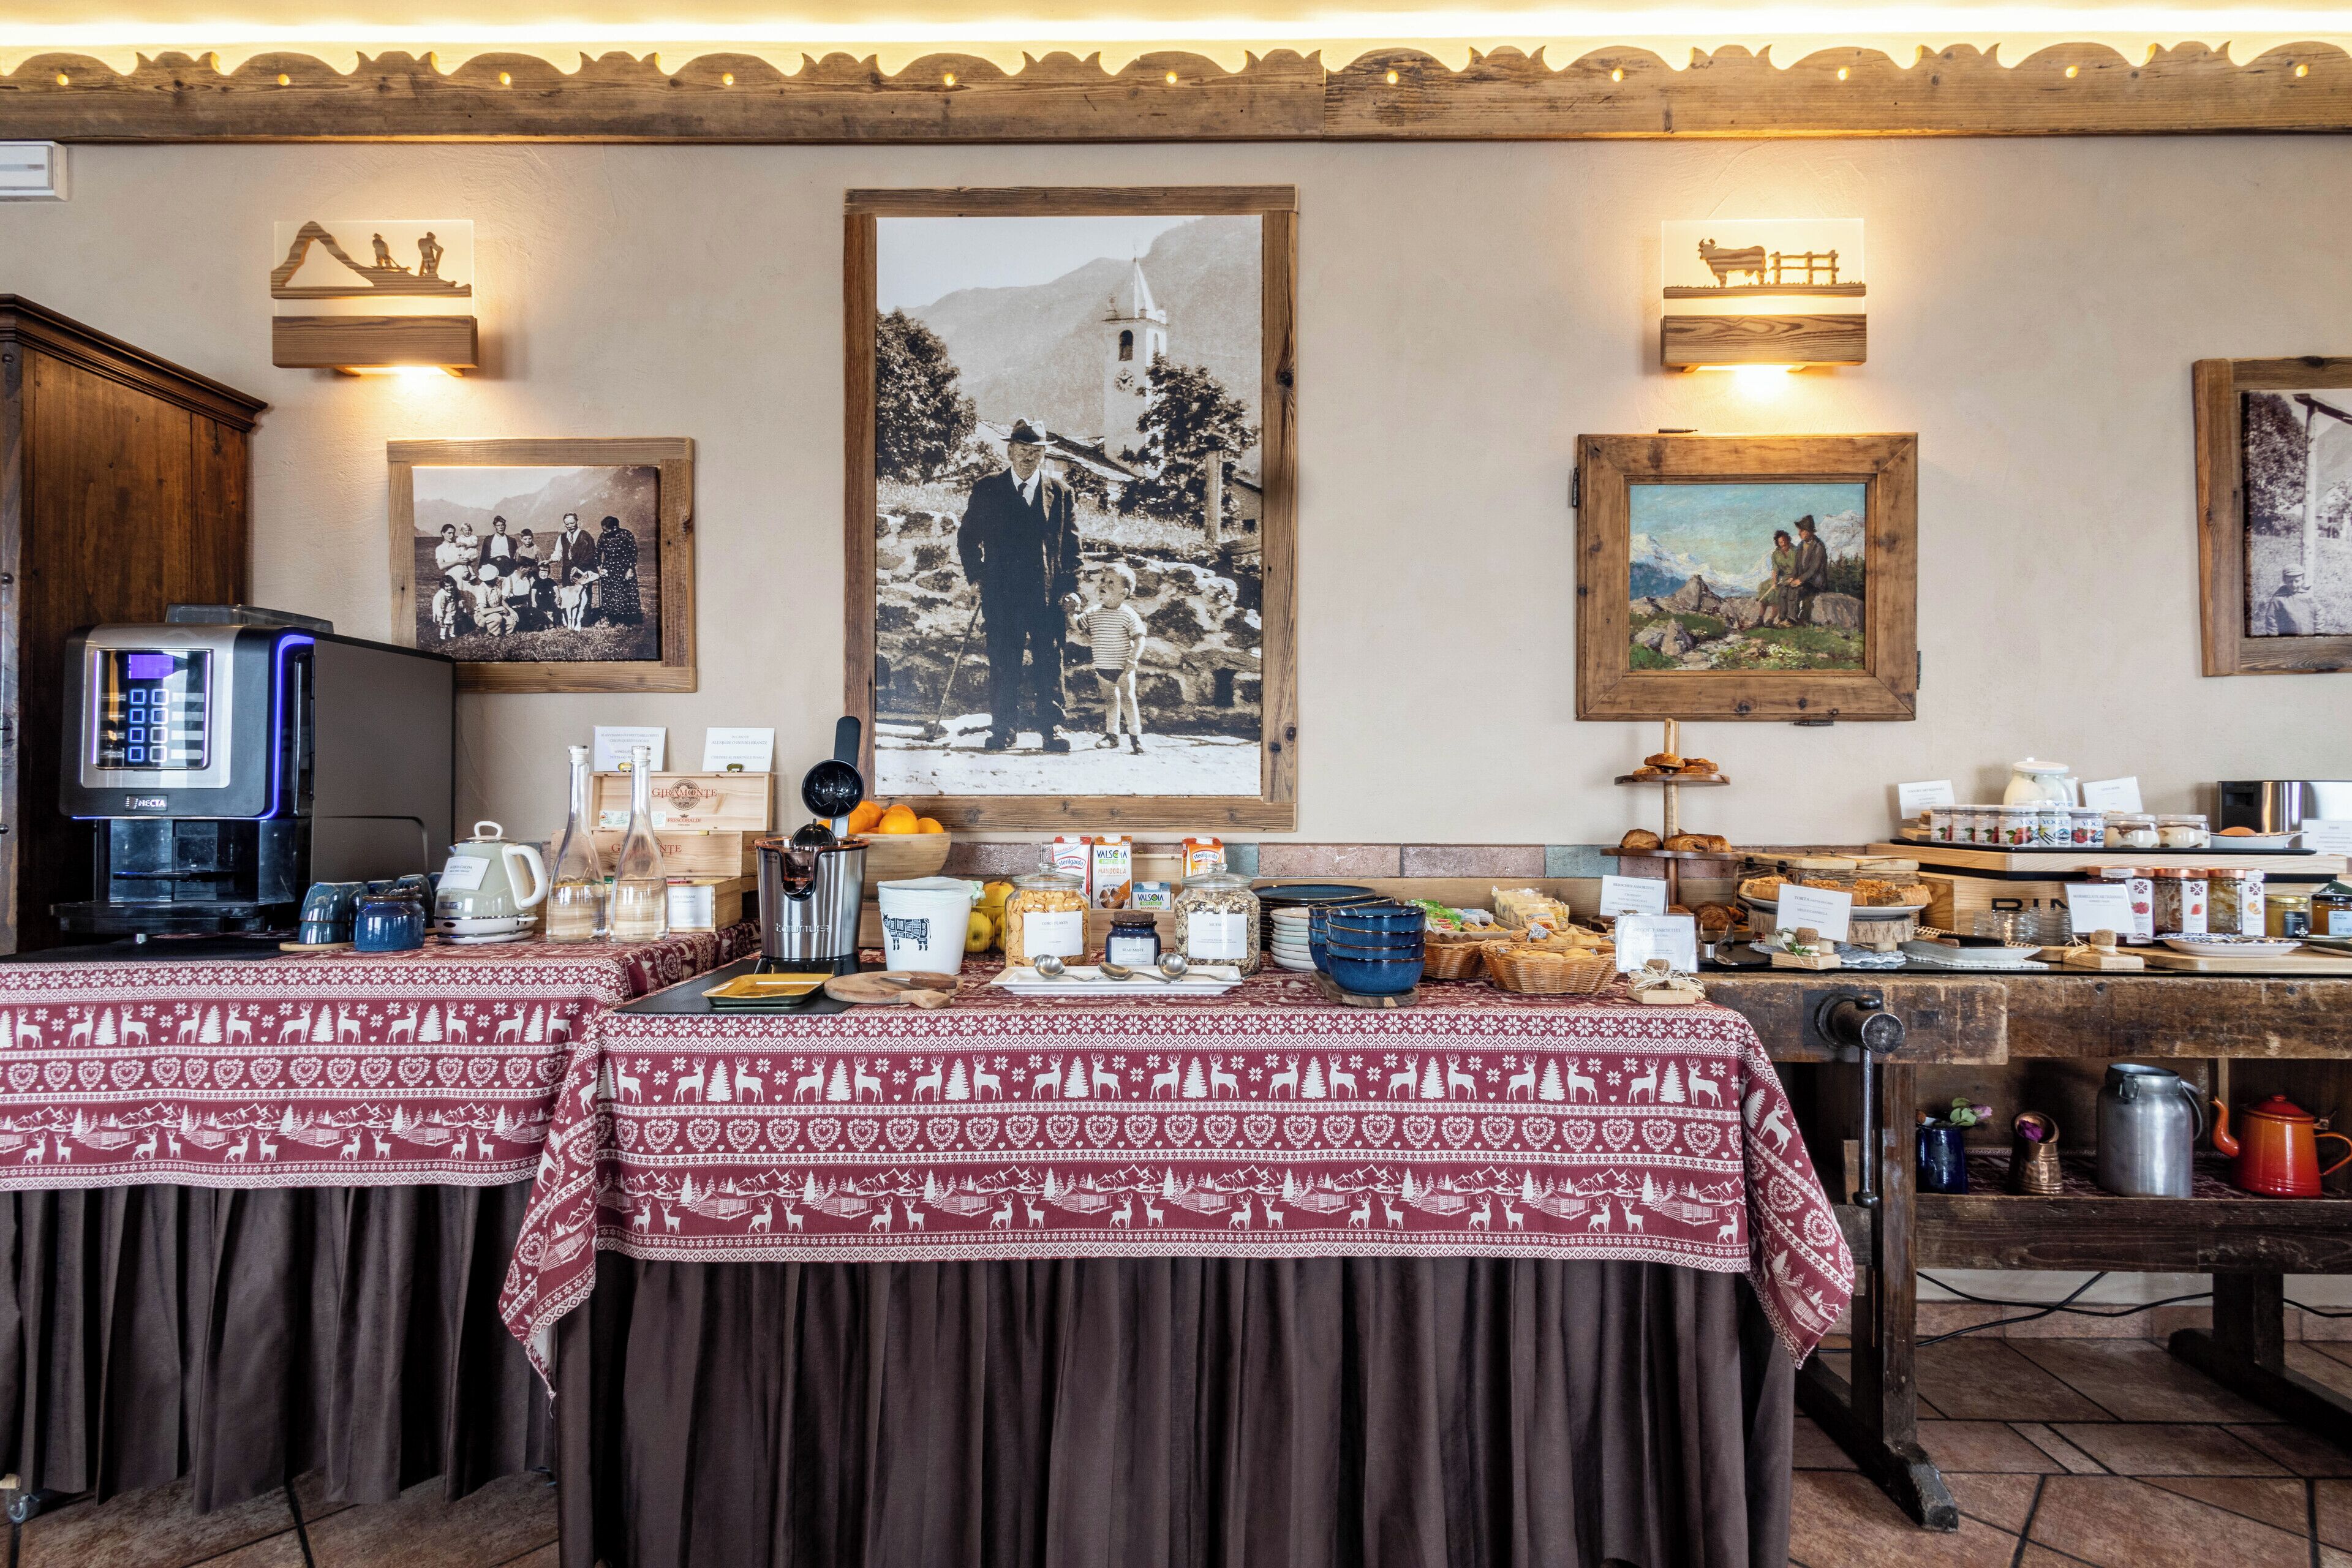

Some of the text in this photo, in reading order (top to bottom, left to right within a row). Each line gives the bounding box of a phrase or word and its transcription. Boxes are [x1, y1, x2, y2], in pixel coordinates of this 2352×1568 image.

[652, 788, 717, 798] GIRAMONTE
[1058, 858, 1084, 867] sterilgarda
[776, 922, 829, 933] taurus
